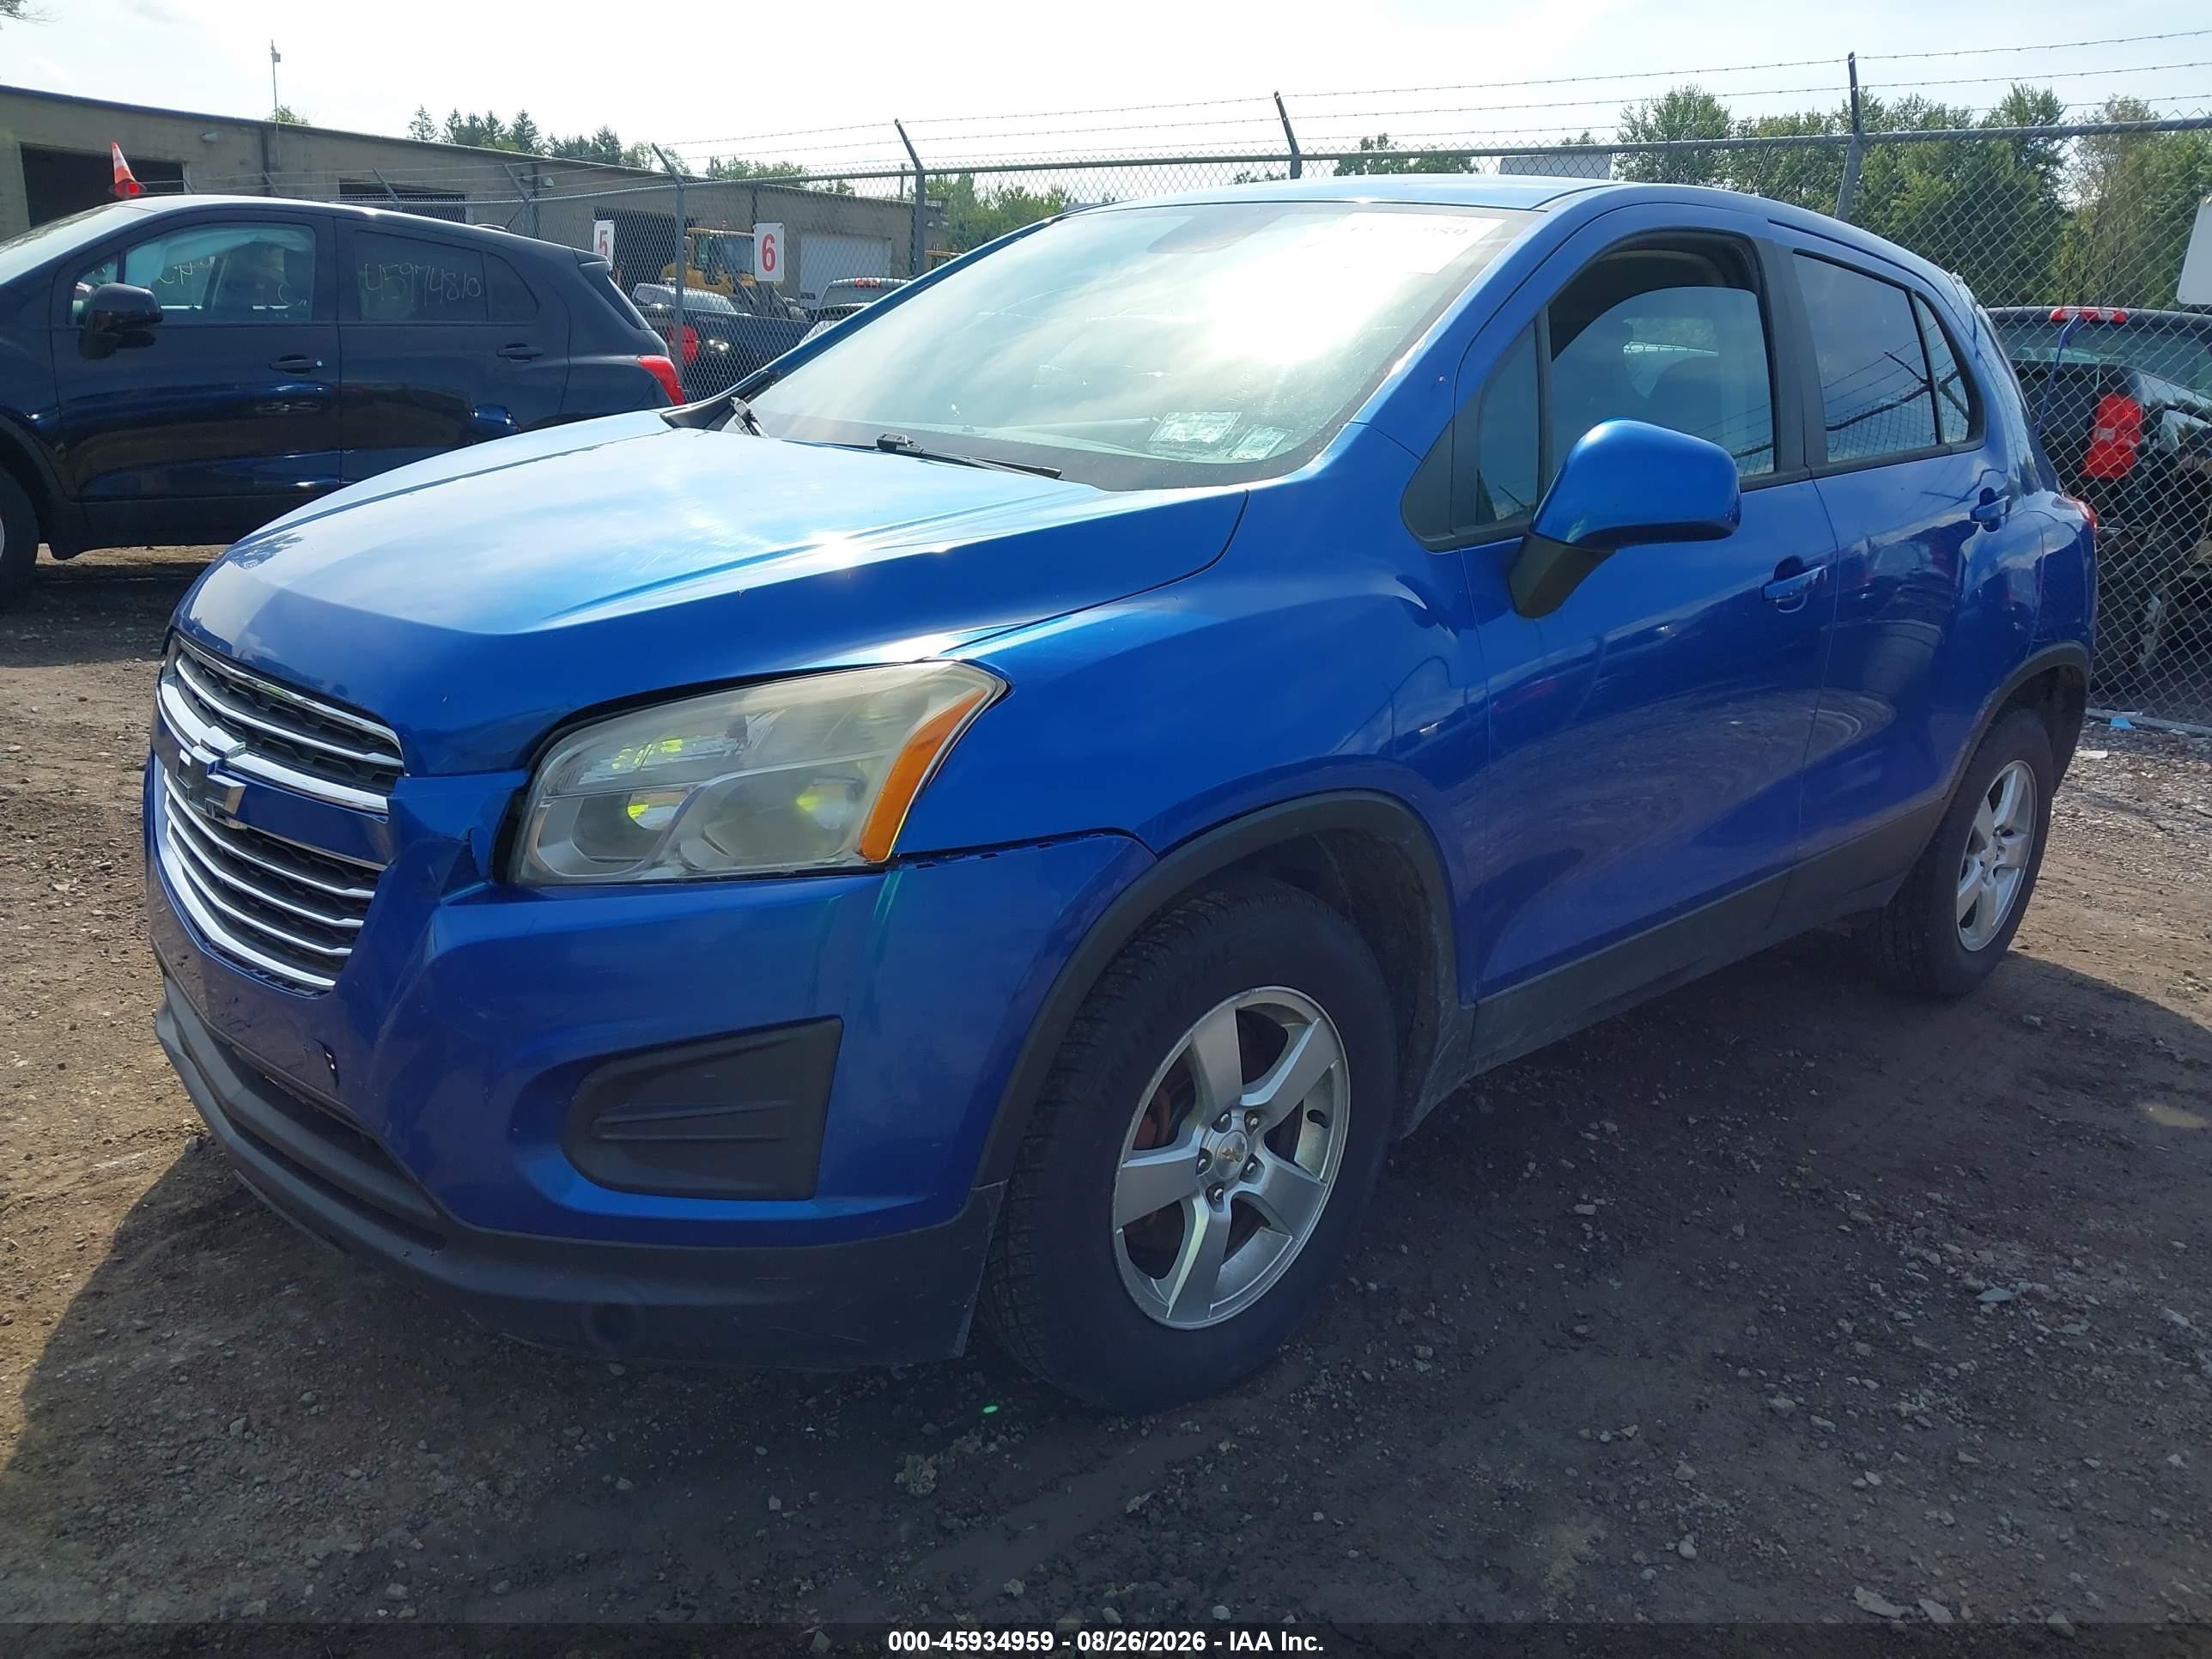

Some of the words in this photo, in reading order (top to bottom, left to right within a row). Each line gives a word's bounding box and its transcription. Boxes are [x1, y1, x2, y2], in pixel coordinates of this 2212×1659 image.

[599, 228, 609, 258] 5
[761, 233, 776, 272] 6
[363, 260, 482, 307] 45974810
